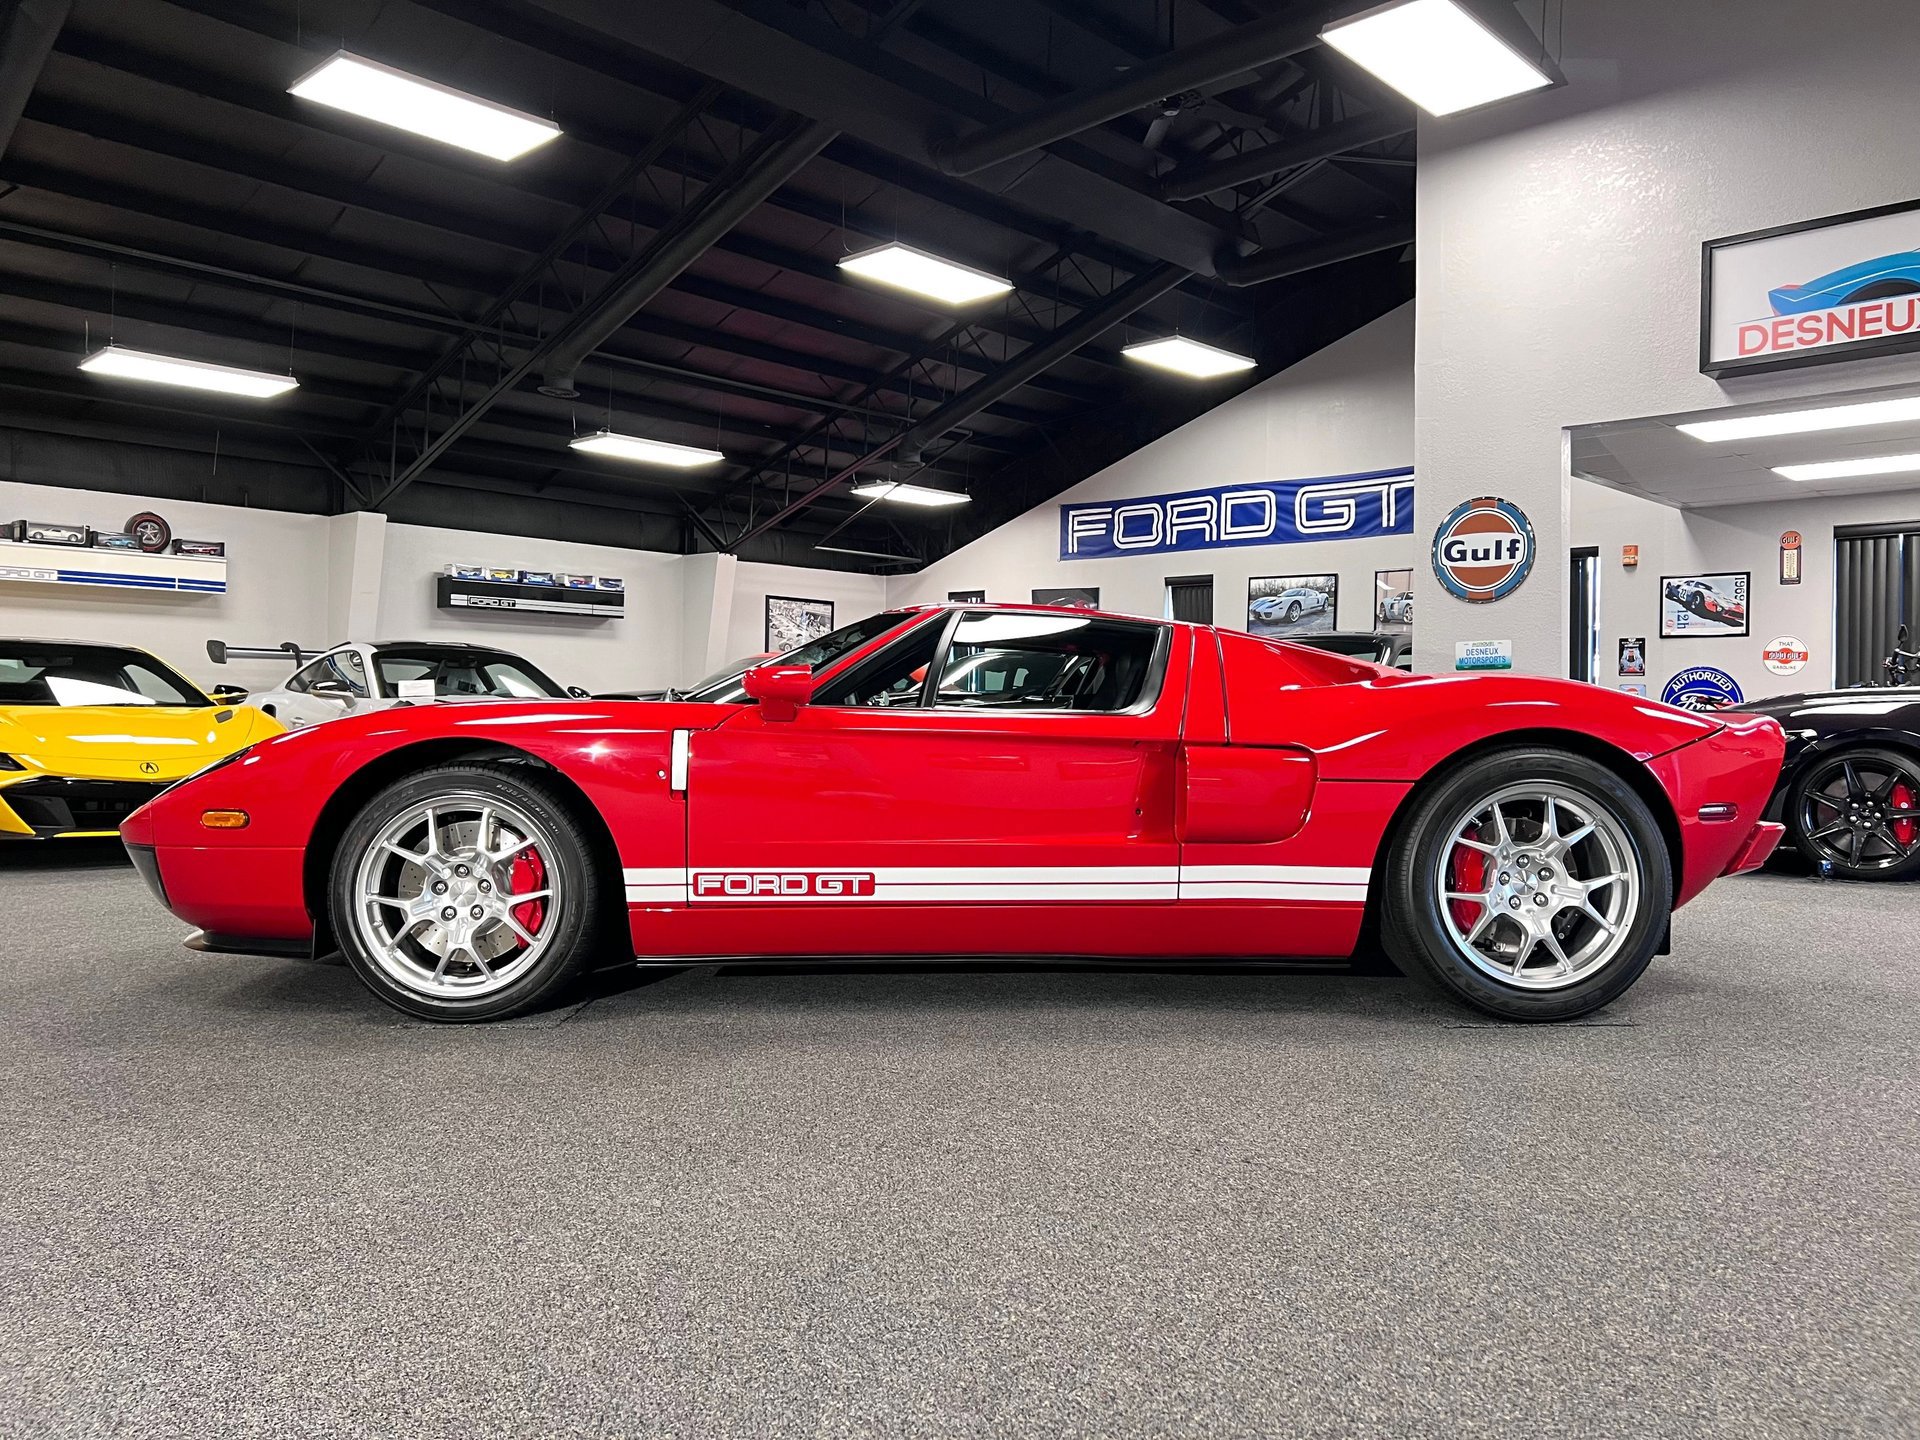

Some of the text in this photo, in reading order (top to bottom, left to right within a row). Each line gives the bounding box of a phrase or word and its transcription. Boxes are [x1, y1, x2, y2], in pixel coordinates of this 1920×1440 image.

[1738, 297, 1920, 356] DESNEU
[1068, 474, 1415, 554] FORD GT
[1781, 536, 1799, 545] GULF
[1444, 538, 1521, 563] Gulf
[0, 568, 55, 579] ORD GT
[1734, 577, 1745, 601] 1969
[470, 598, 499, 606] FORD
[1677, 610, 1689, 629] 12h
[1458, 655, 1507, 665] MOTORSPORTS
[1465, 647, 1499, 657] DESNEUX
[1786, 651, 1804, 661] GULF
[1671, 671, 1733, 692] AUTHORIZED
[698, 874, 870, 895] FORD GT
